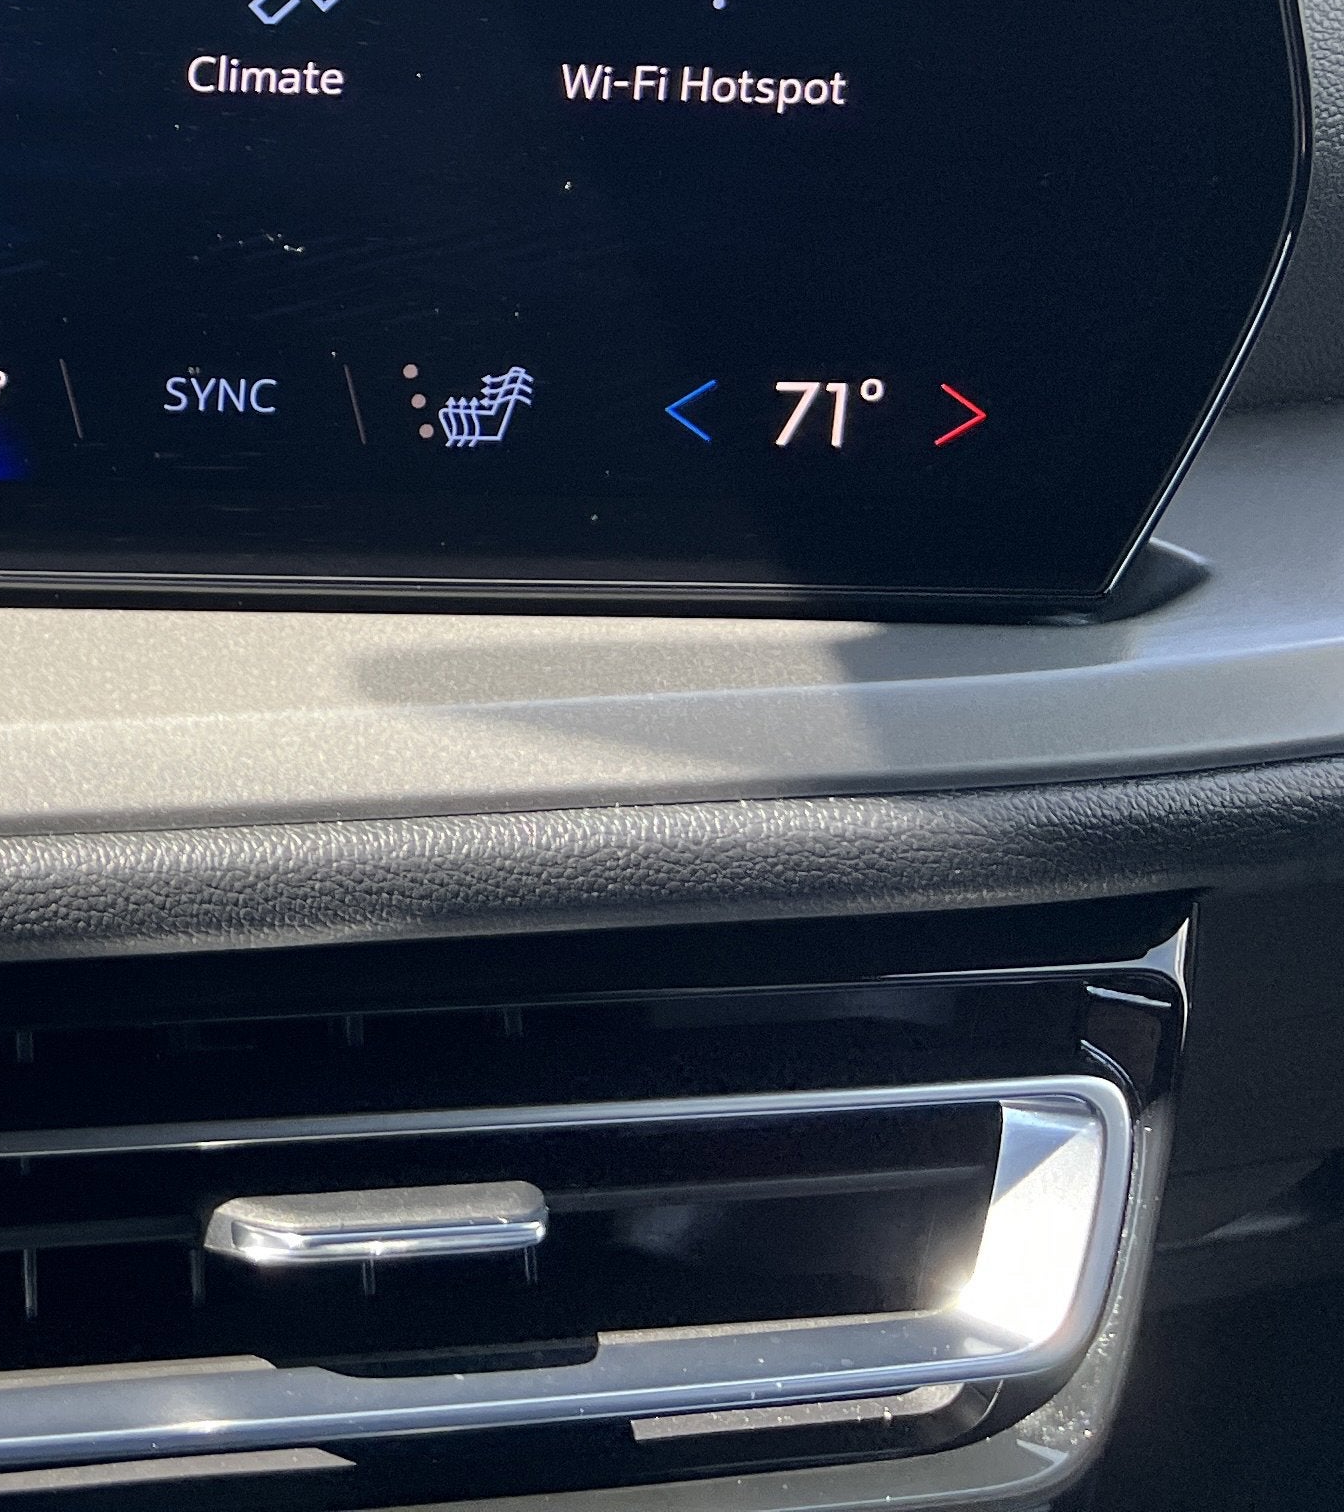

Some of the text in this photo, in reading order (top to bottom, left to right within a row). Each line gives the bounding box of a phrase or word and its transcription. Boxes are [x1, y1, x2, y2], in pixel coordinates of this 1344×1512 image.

[186, 53, 345, 96] Climate
[560, 62, 848, 114] Wi-Fi Hotspot
[162, 375, 278, 414] SYNC
[774, 377, 885, 449] 71°
